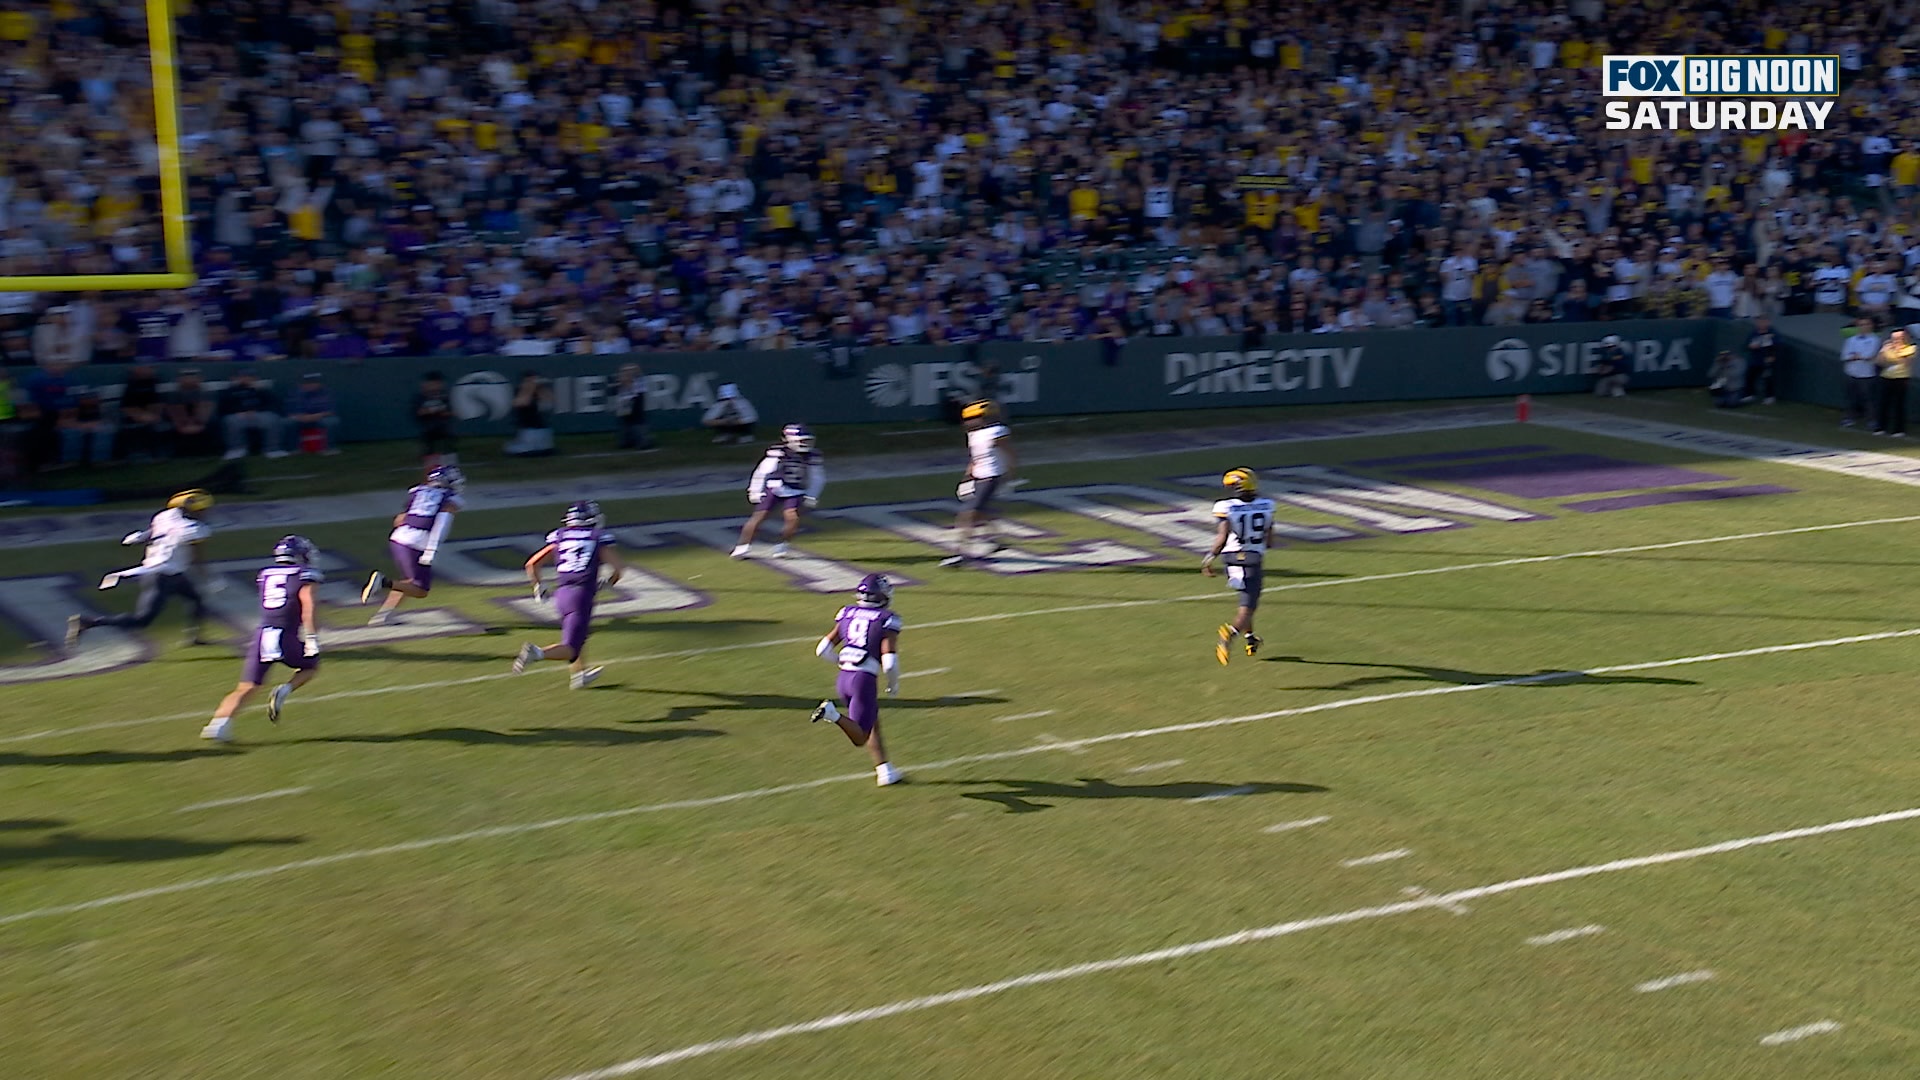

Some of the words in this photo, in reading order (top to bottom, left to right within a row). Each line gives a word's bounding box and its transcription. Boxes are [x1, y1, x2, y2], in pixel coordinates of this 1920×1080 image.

[1165, 346, 1364, 396] DIRECTV
[1537, 337, 1693, 377] SIERA
[522, 371, 719, 415] IERA
[1237, 512, 1265, 544] 19
[262, 575, 288, 609] 5
[846, 616, 870, 647] 9
